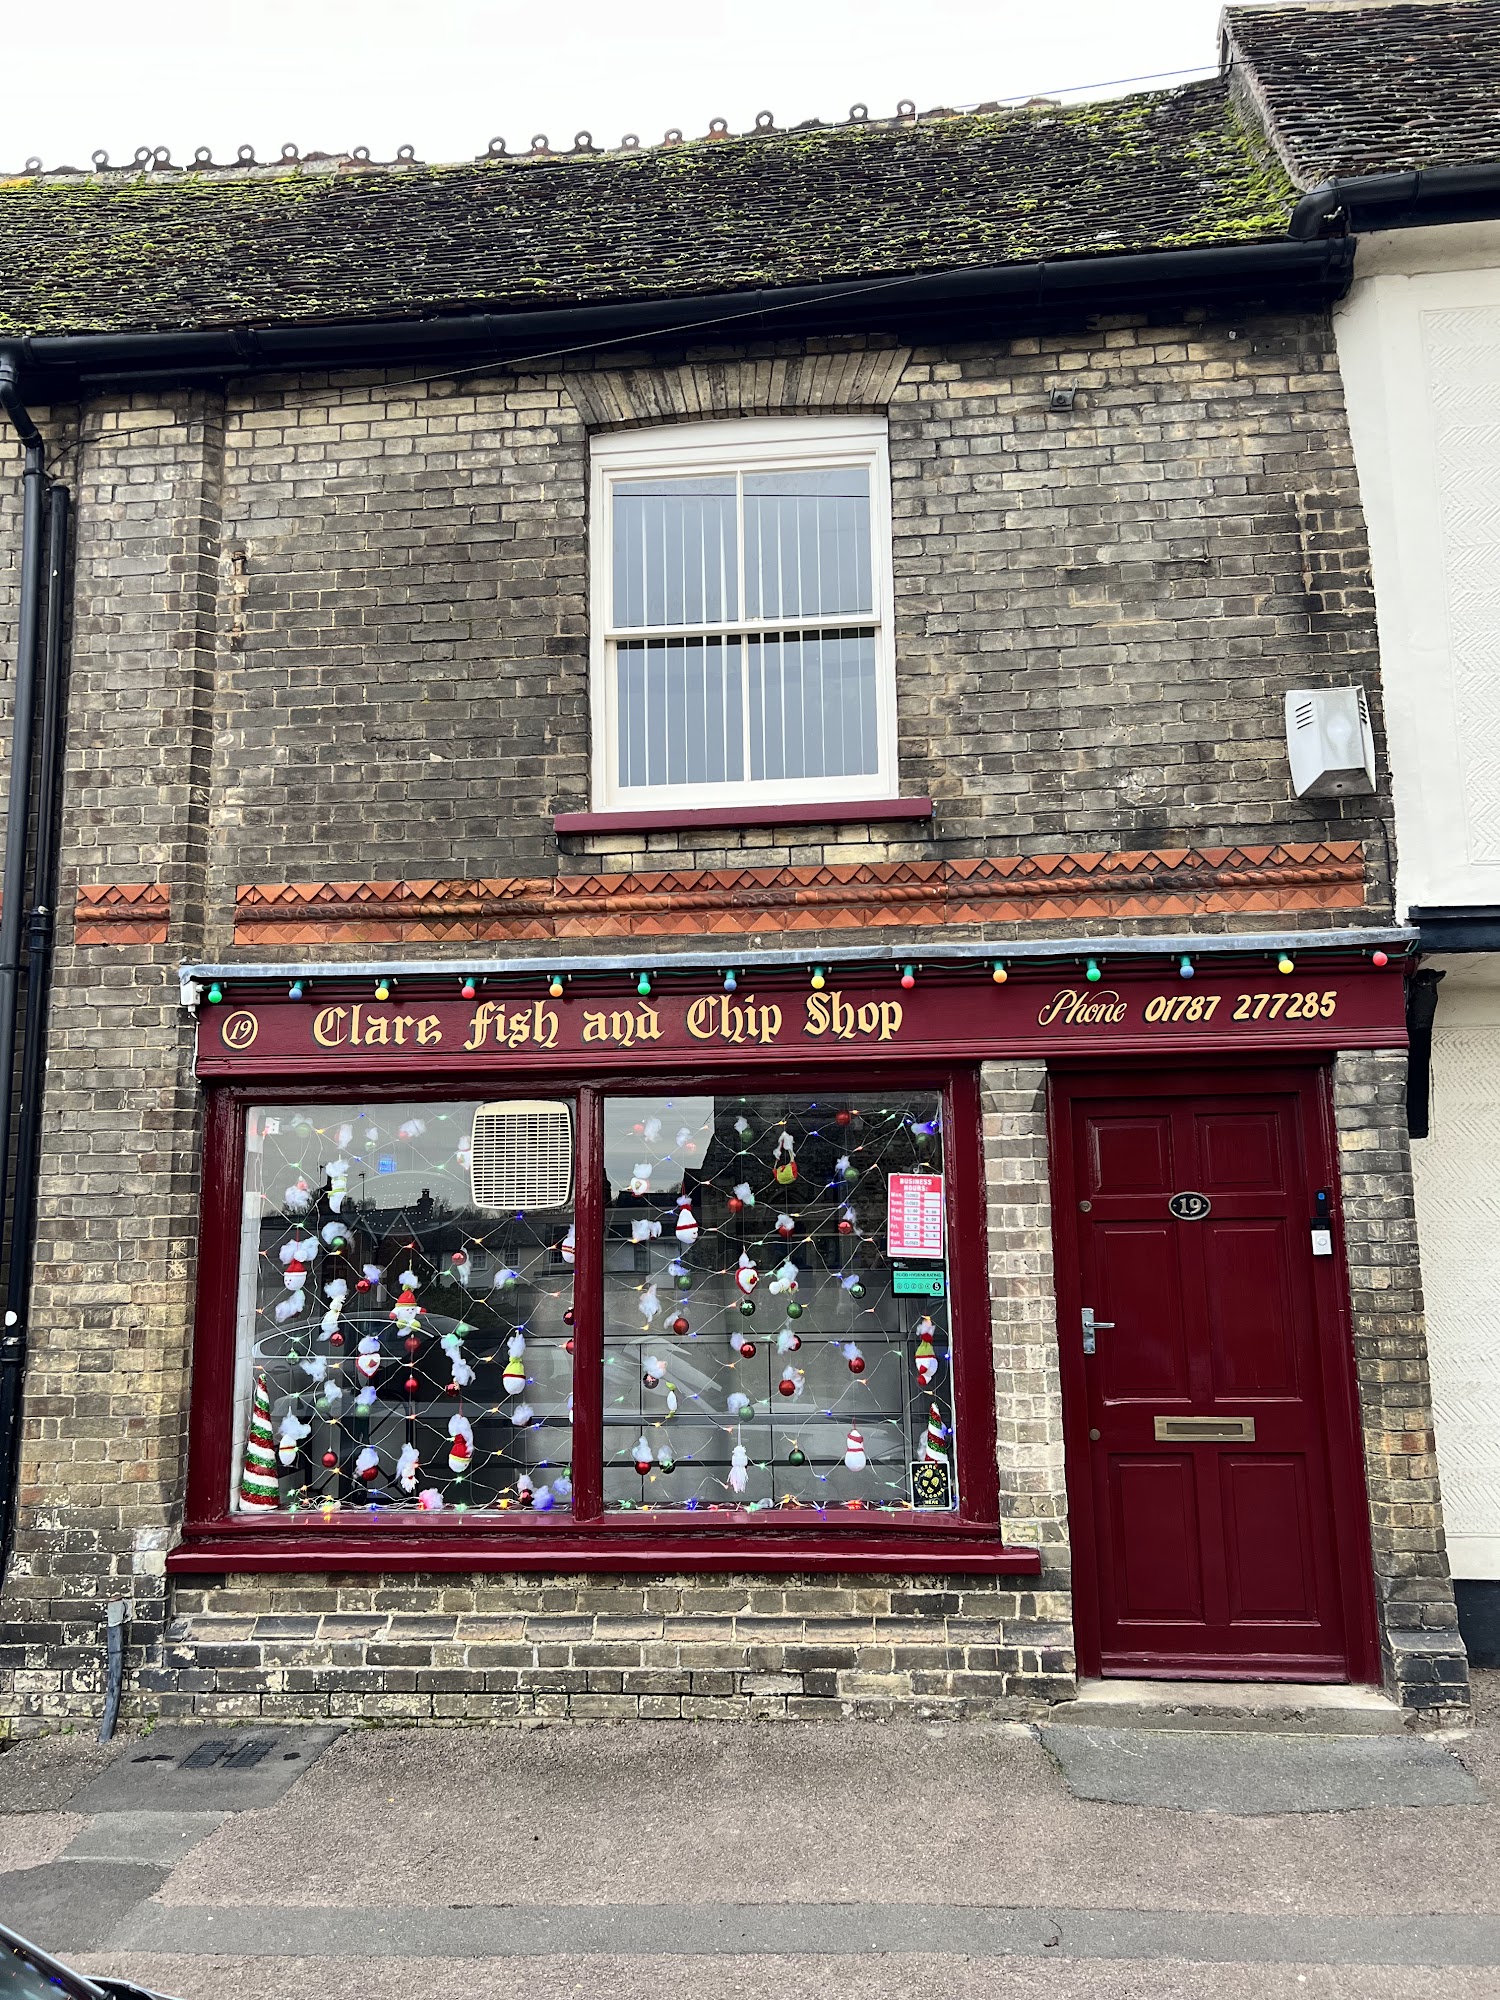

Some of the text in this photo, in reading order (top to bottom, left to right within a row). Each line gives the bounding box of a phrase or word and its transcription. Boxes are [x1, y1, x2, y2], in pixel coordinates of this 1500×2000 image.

[313, 1003, 442, 1047] Clare
[582, 1001, 665, 1047] and
[687, 994, 783, 1044] Chip
[804, 991, 903, 1041] Shop
[1038, 989, 1338, 1026] Phone 01787 277285
[229, 1020, 252, 1040] 19
[1179, 1198, 1202, 1215] 19
